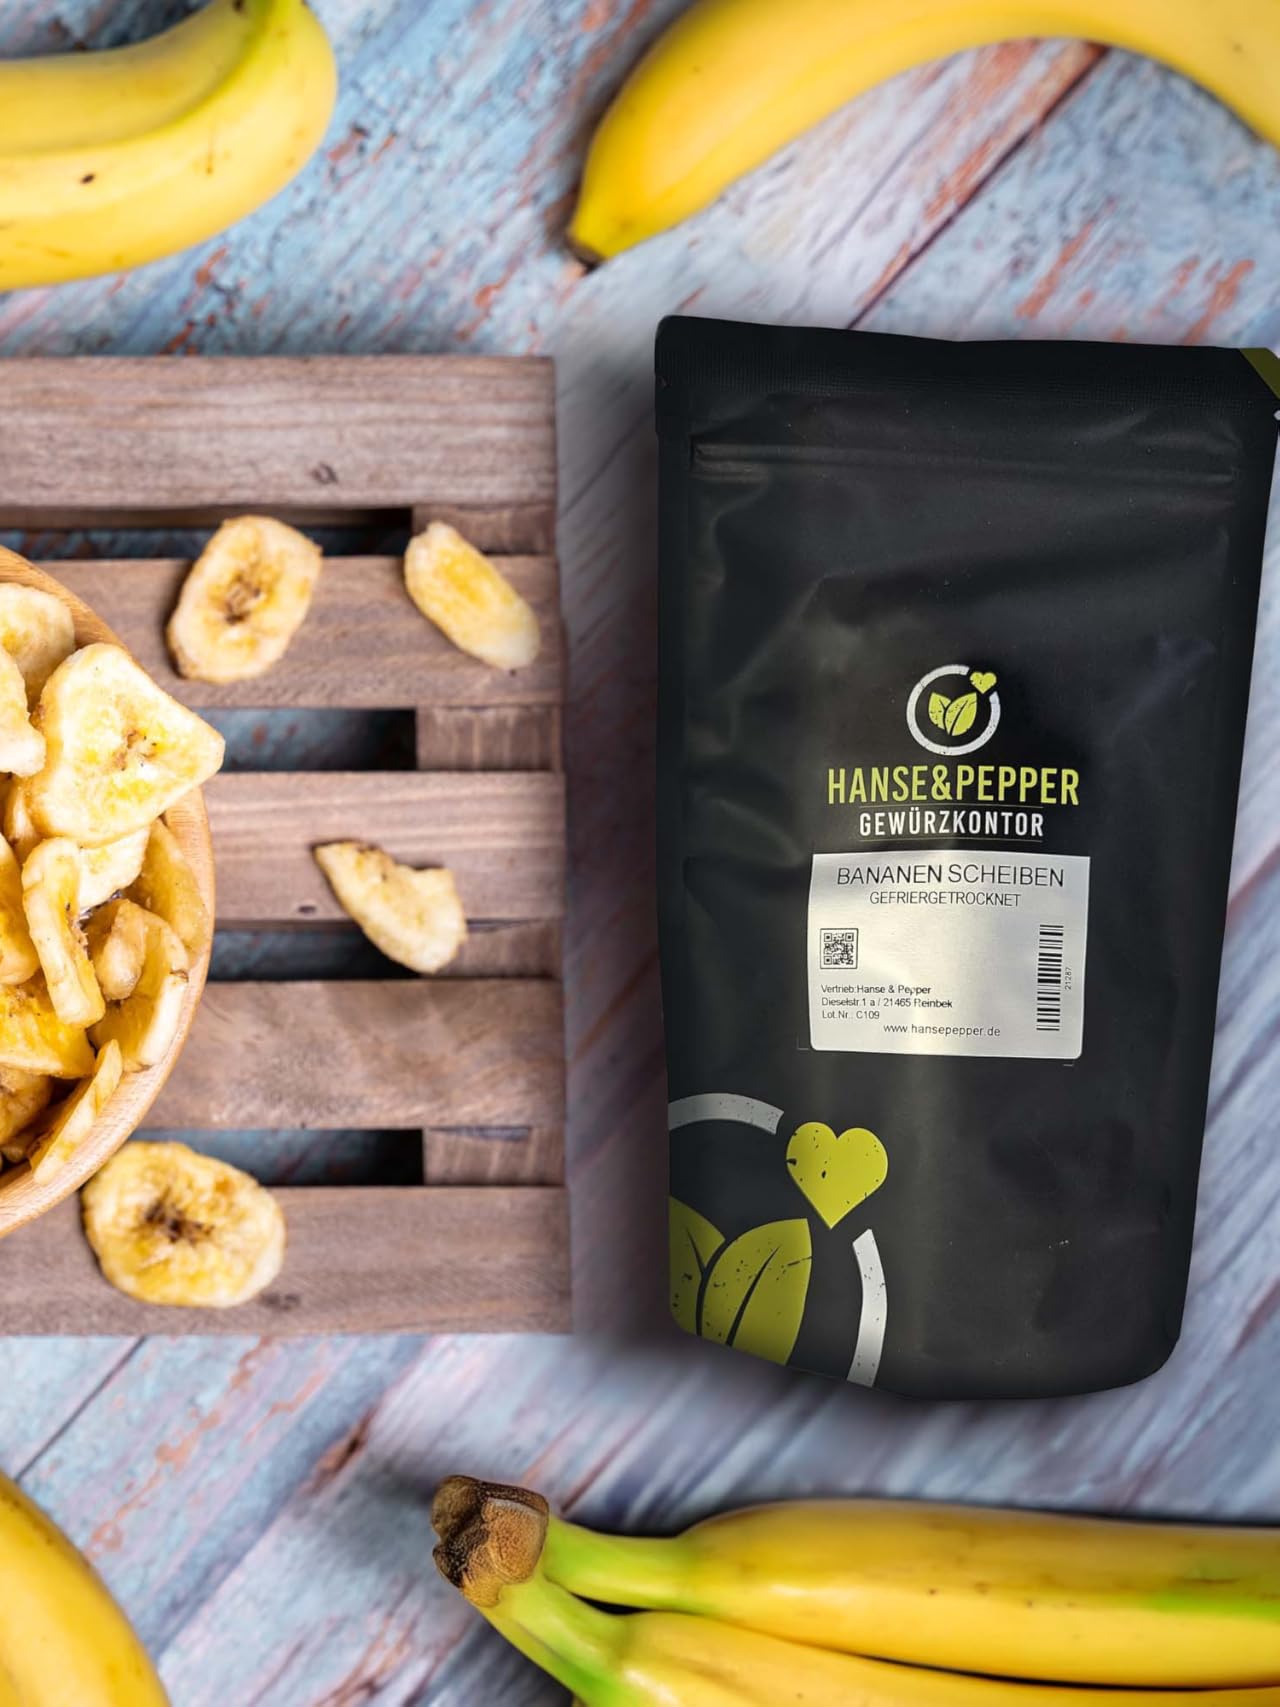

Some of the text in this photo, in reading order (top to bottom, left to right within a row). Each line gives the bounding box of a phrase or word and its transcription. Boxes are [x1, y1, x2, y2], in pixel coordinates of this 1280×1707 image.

[827, 764, 1080, 806] HANSE&PEPPER
[859, 807, 1044, 837] GEWÜRZKONTOR
[837, 863, 1065, 888] BANANEN SCHEIBEN
[869, 891, 1021, 907] GEFRIERGETROCKNET
[888, 984, 895, 994] &
[898, 984, 932, 996] Pepper
[870, 999, 876, 1007] a
[883, 997, 912, 1007] 21465
[914, 998, 953, 1008] Reinbek
[856, 1010, 880, 1020] C109
[883, 1023, 1001, 1037] www.hansepepper.de
